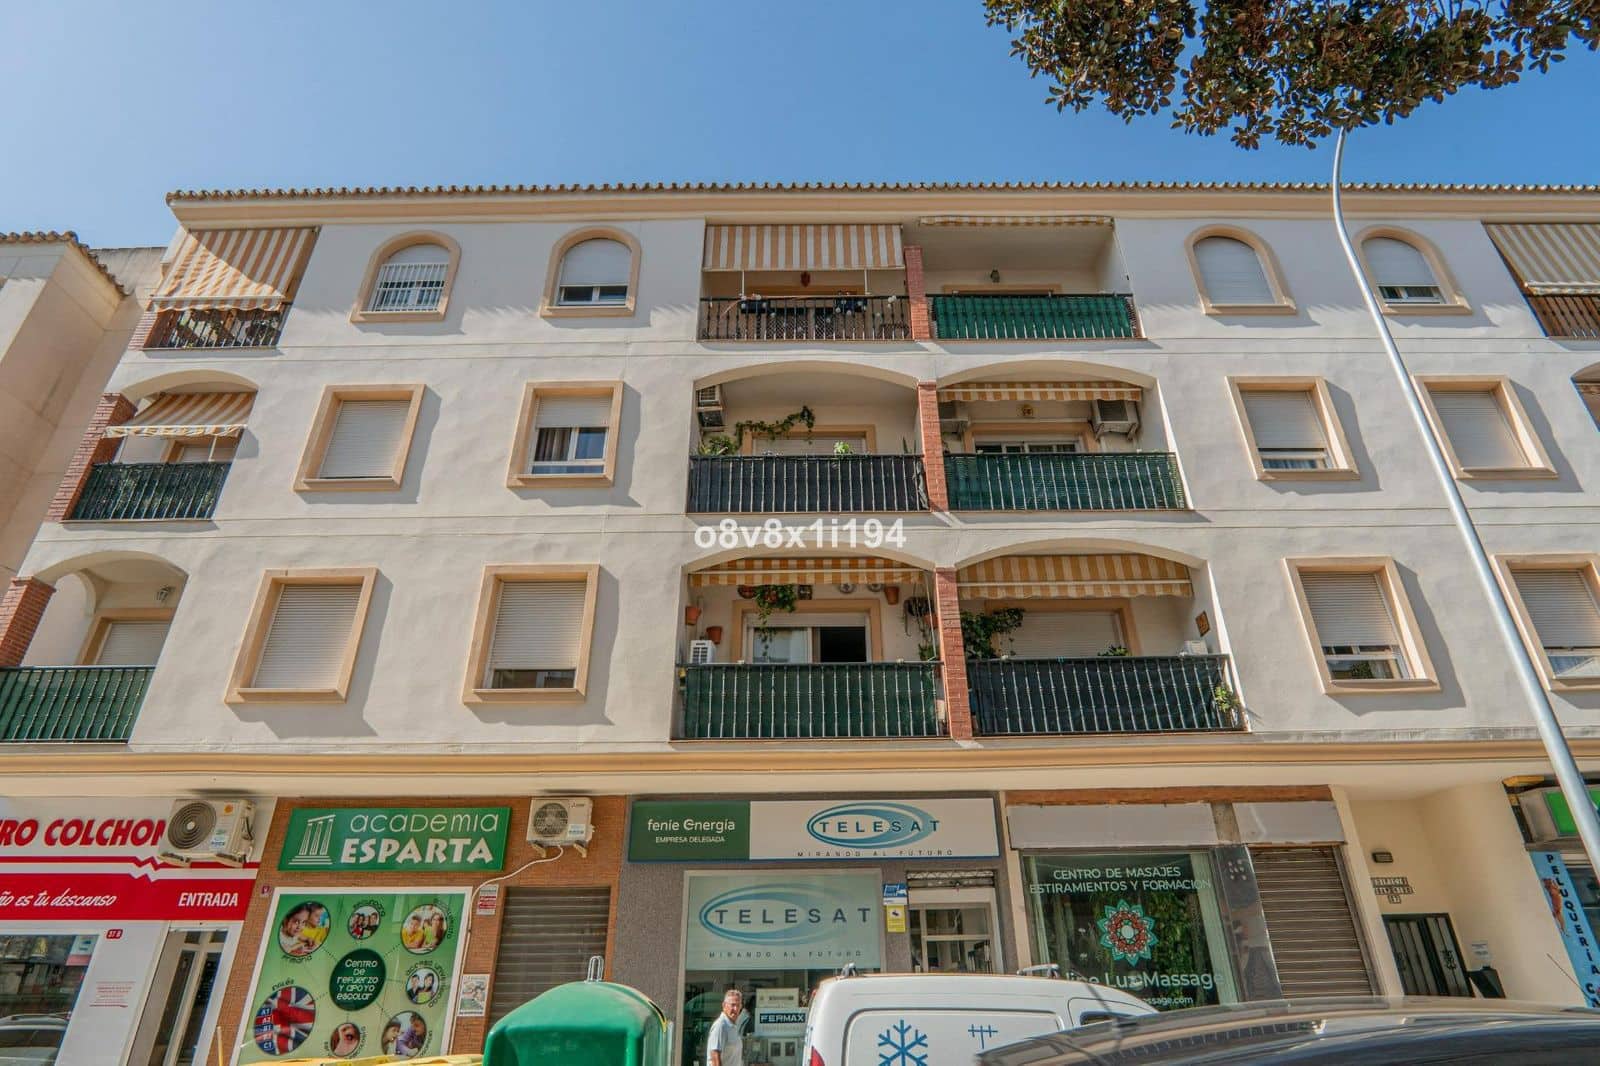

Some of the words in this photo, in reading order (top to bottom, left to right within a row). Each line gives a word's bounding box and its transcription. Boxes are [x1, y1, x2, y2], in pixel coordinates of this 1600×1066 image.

[0, 818, 39, 846] RO
[819, 820, 940, 833] TELESAT
[340, 837, 494, 864] ESPARTA
[1053, 869, 1101, 880] CENTRO
[1105, 868, 1122, 879] DE
[1126, 866, 1181, 879] MASAJES
[1029, 880, 1128, 894] ESTIRAMIENTOS
[1130, 880, 1138, 890] Y
[15, 895, 34, 906] es
[34, 890, 50, 906] tu
[50, 888, 118, 907] descanso
[178, 892, 239, 907] ENTRADA
[715, 908, 871, 924] TELESAT
[760, 1014, 804, 1023] FERMAX
